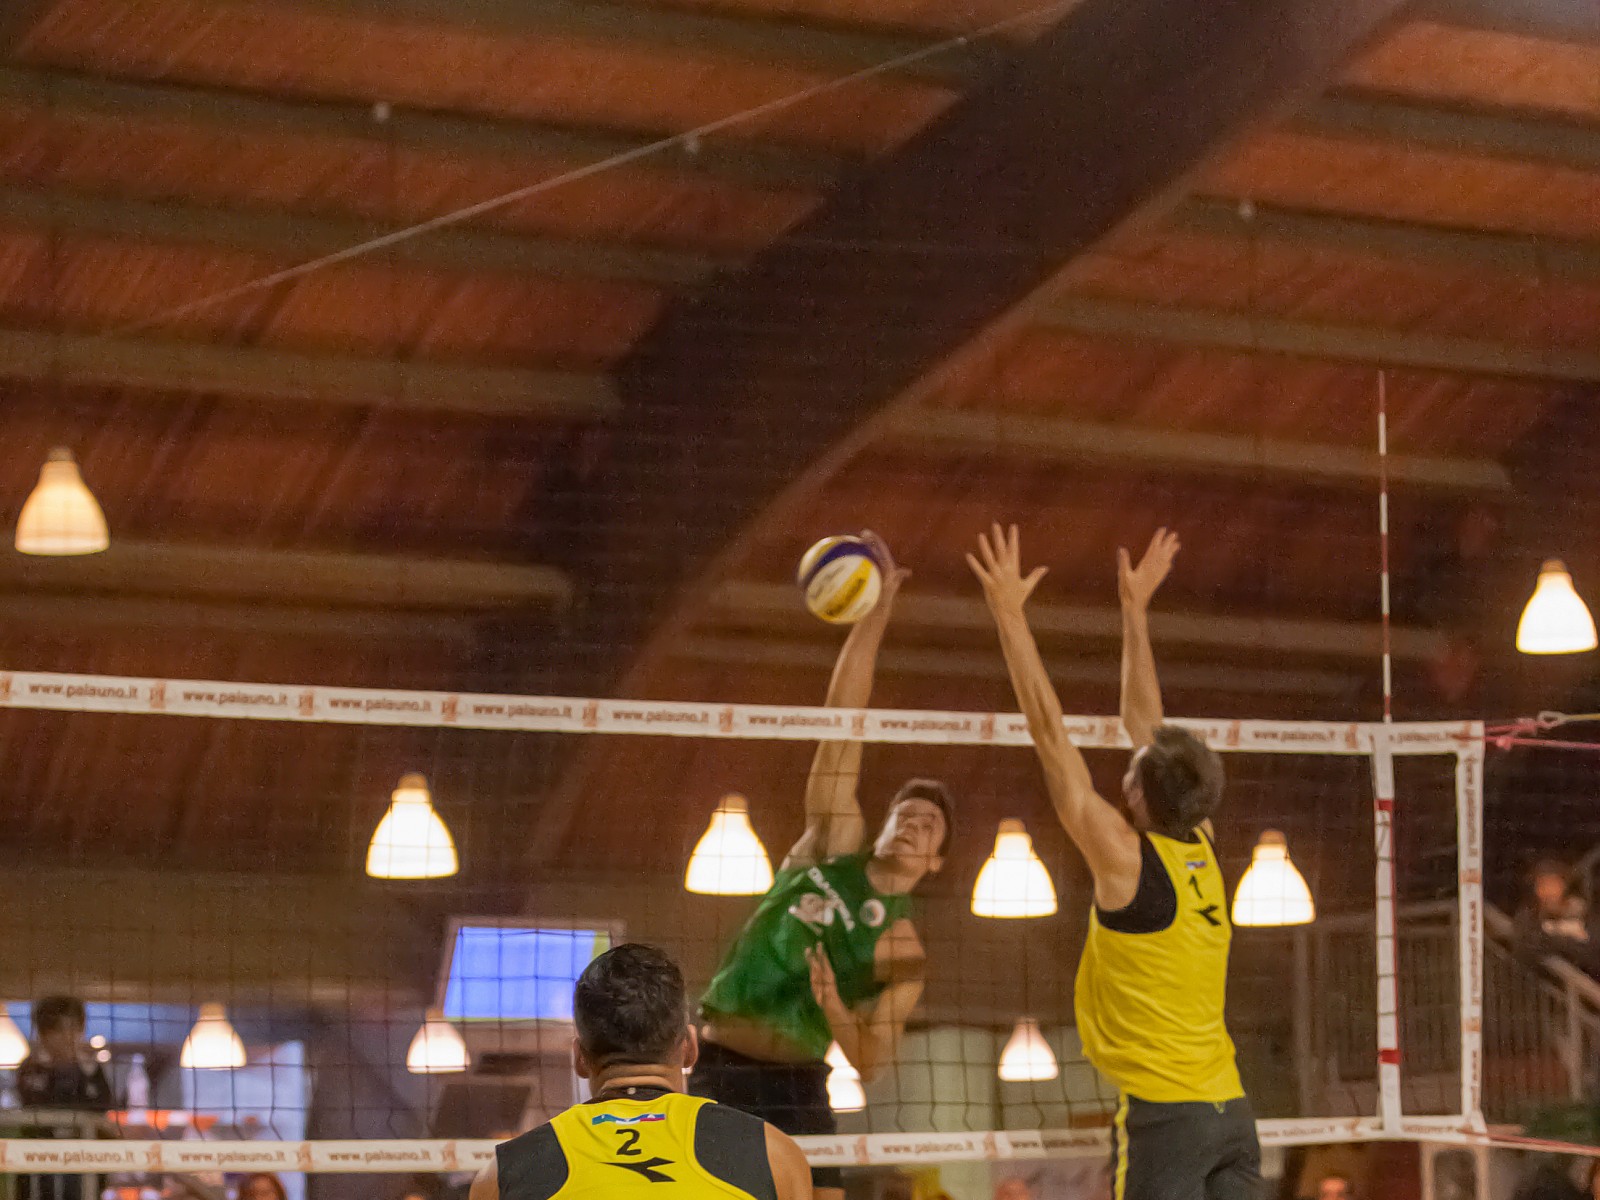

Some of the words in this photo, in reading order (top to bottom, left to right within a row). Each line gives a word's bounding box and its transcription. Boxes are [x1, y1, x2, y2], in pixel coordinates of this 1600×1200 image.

[29, 682, 138, 700] www.palauno.it
[182, 689, 288, 705] www.palauno.it
[615, 1128, 642, 1156] 2
[24, 1150, 135, 1165] www.palauno.it
